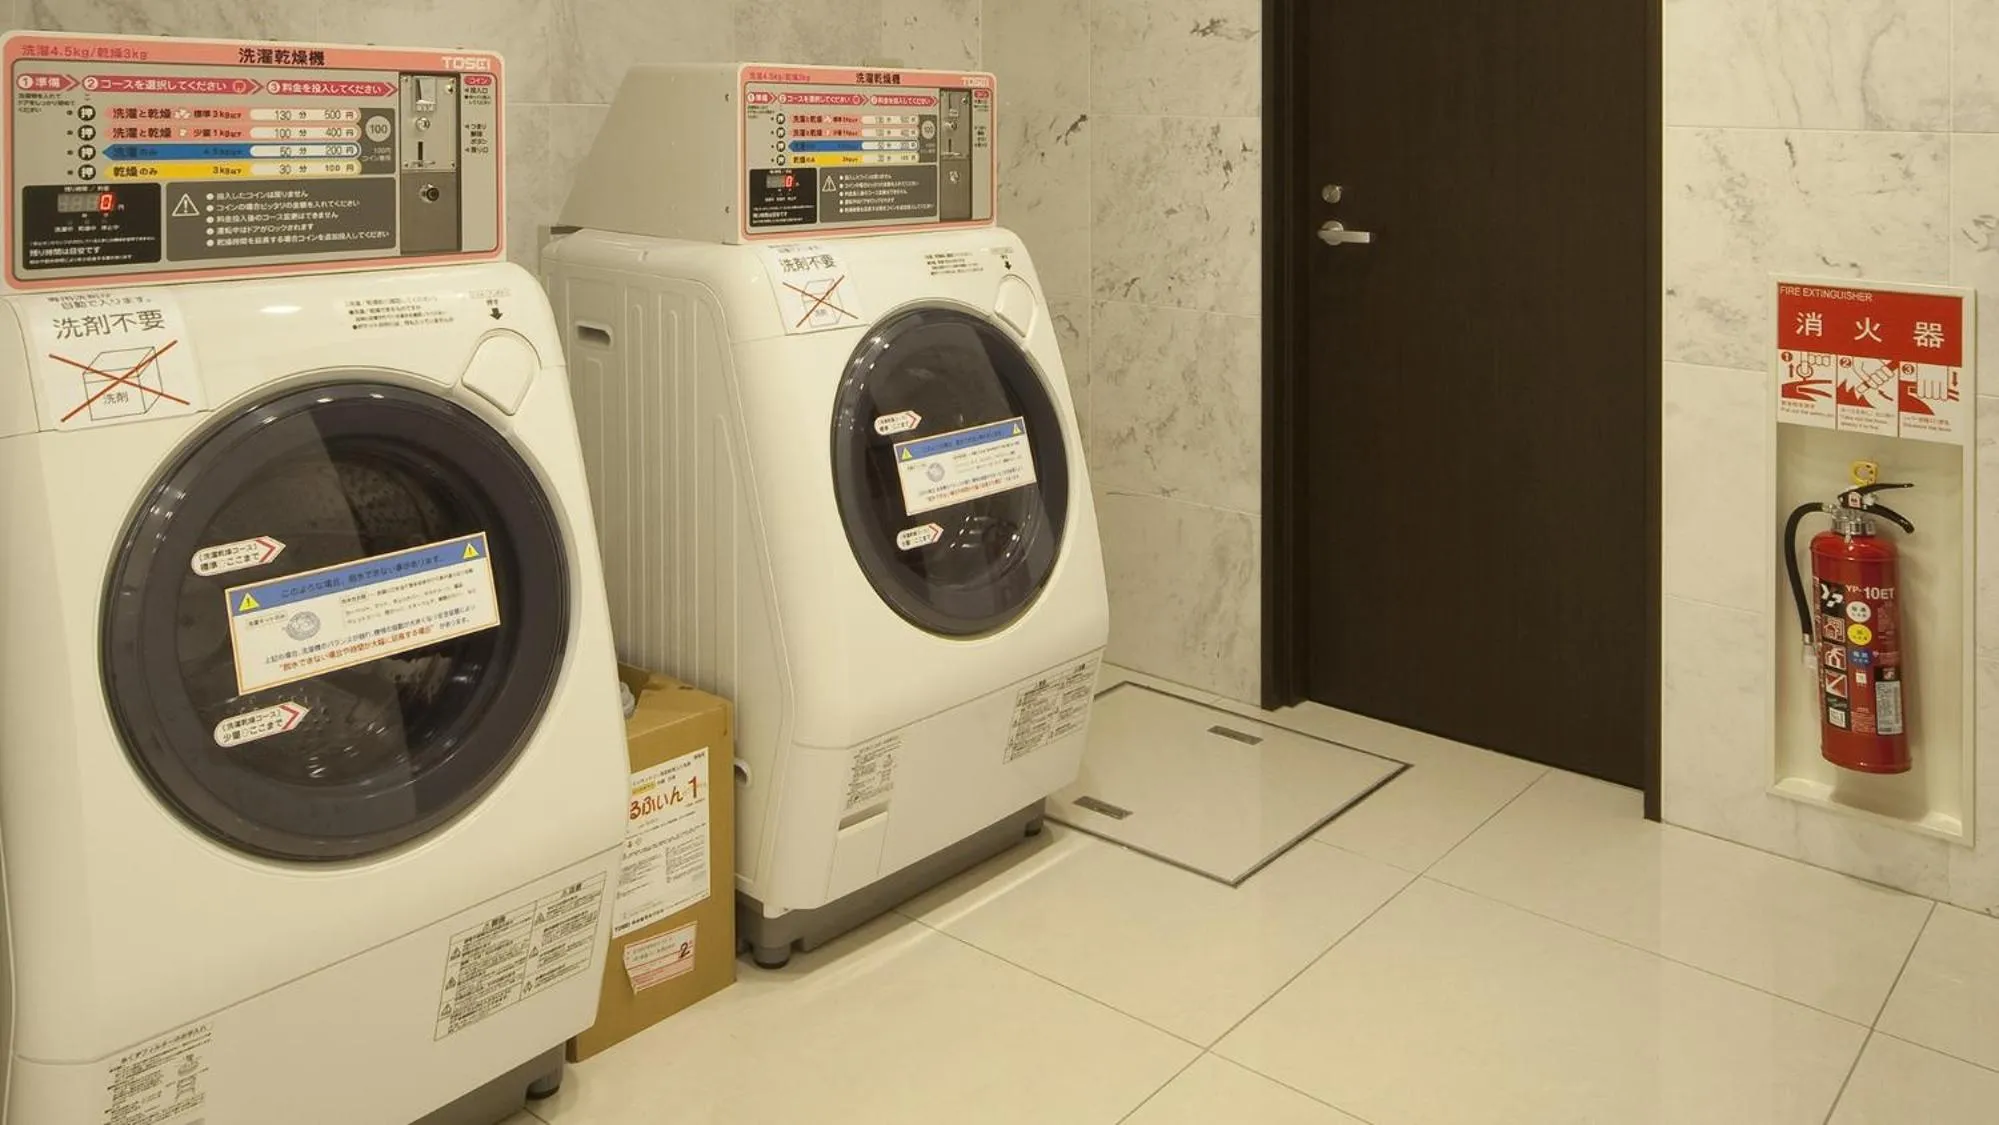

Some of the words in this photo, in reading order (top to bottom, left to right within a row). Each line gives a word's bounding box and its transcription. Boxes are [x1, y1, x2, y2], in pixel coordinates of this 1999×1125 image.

[238, 47, 325, 66] 洗濯乾燥機
[441, 55, 490, 71] TOSEI
[35, 77, 60, 88] 準備
[101, 79, 227, 91] コースを選択してください
[282, 83, 383, 94] 料金を投入してください
[113, 108, 171, 119] 洗濯と乾燥
[275, 110, 291, 121] 130
[324, 109, 341, 119] 500
[113, 127, 171, 138] 洗濯と乾燥
[275, 128, 291, 139] 100
[325, 128, 341, 137] 400
[369, 124, 388, 133] 100
[113, 166, 158, 177] 乾燥のみ
[279, 164, 291, 175] 30
[100, 194, 113, 211] 0
[779, 254, 837, 272] 洗剤不要
[1780, 285, 1801, 297] FIRE
[1803, 287, 1873, 302] EXTINGUISHER
[53, 309, 165, 340] 洗剤不要
[103, 390, 129, 405] 洗剤
